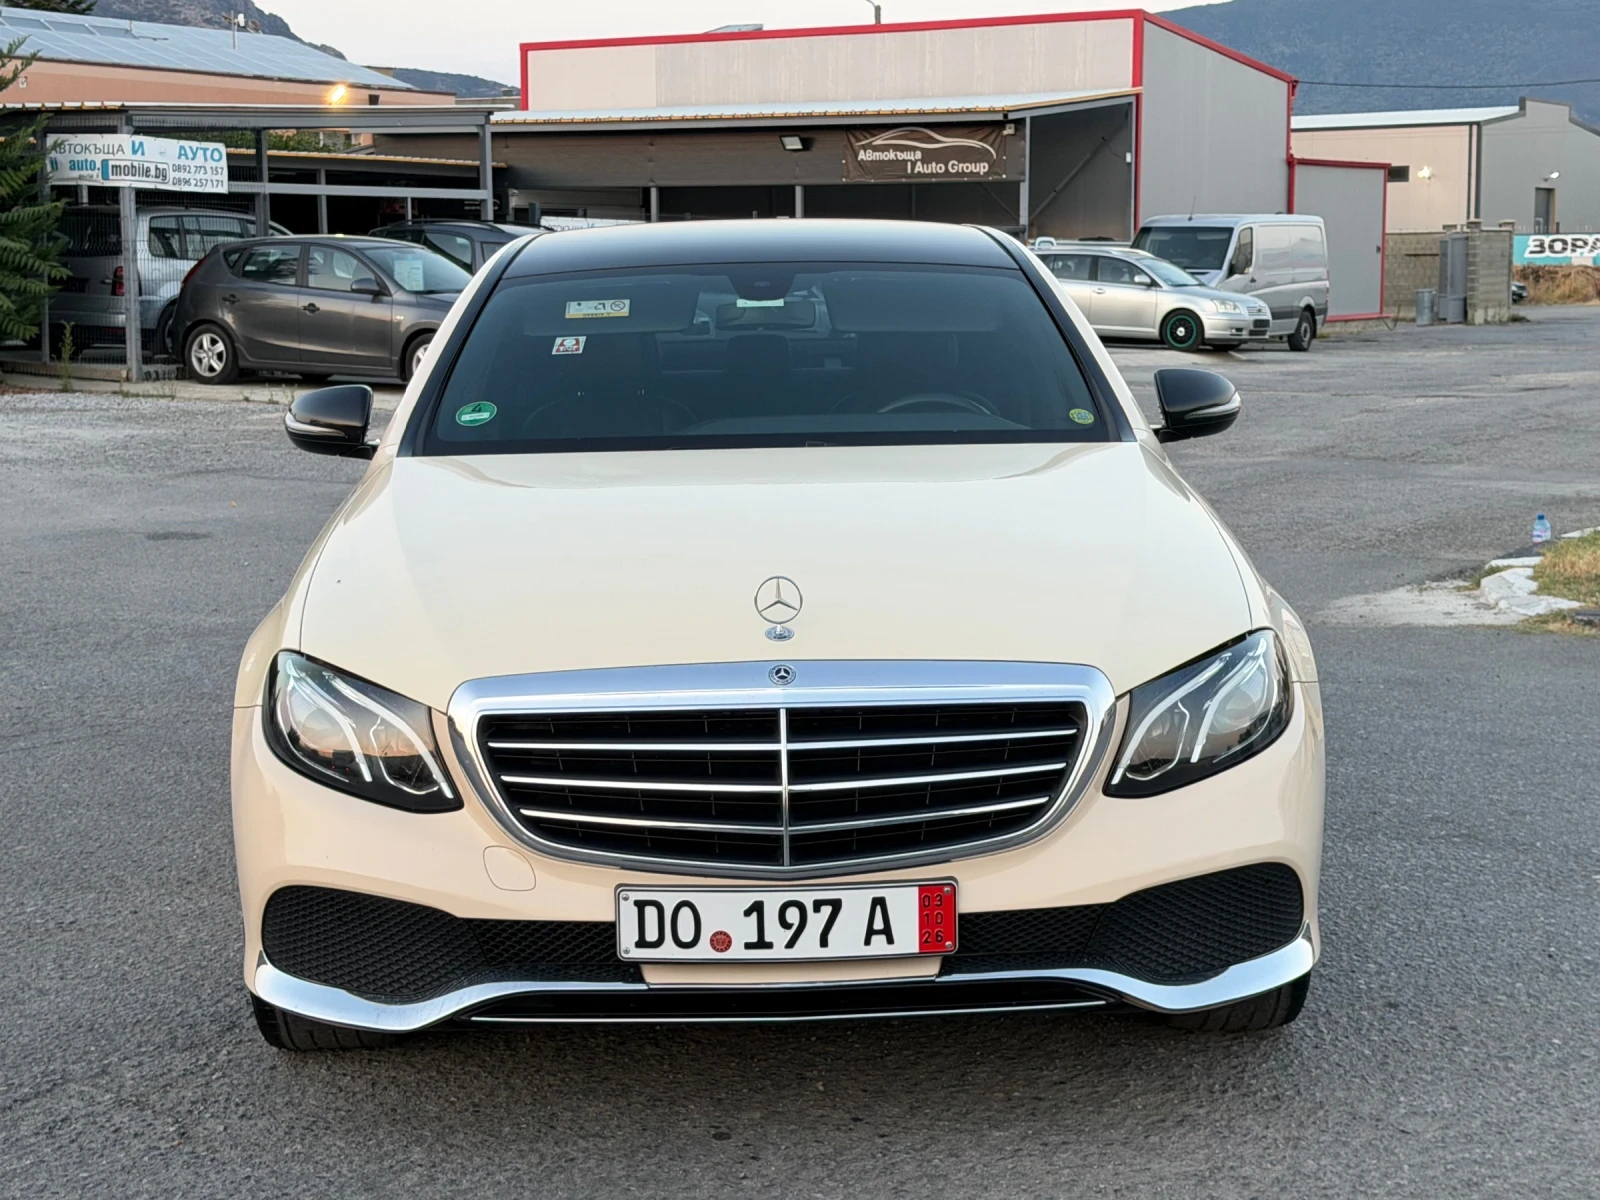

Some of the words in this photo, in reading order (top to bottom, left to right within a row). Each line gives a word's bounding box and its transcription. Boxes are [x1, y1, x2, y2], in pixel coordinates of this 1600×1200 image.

[178, 145, 223, 162] АУТО
[111, 161, 168, 181] mobile.bg
[172, 163, 192, 174] 0892
[193, 165, 208, 175] 773
[210, 166, 224, 176] 157
[913, 161, 945, 174] Auto
[947, 160, 989, 175] Group
[172, 176, 192, 187] 0896
[193, 178, 208, 187] 257
[922, 893, 943, 908] 03
[633, 899, 702, 950] DO
[743, 898, 843, 950] 197
[864, 896, 895, 947] A
[924, 911, 944, 925] 10
[923, 929, 944, 943] 26
